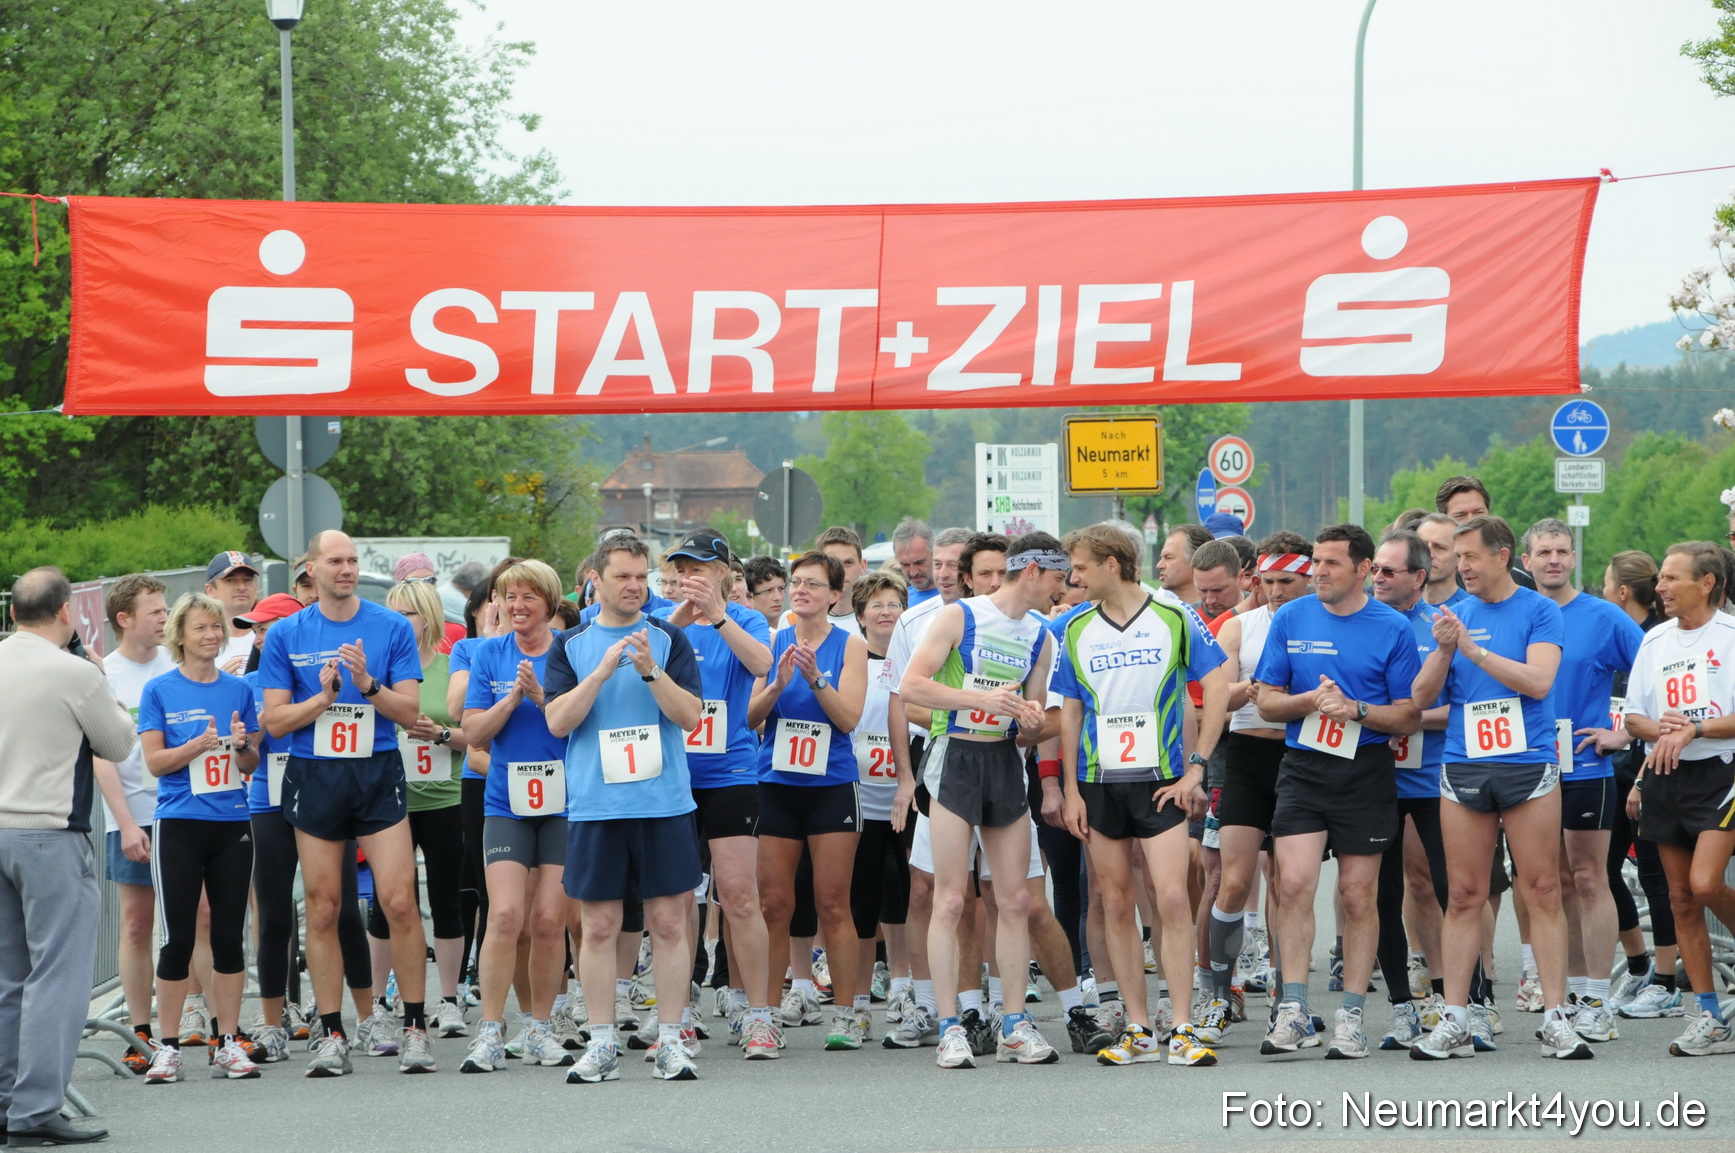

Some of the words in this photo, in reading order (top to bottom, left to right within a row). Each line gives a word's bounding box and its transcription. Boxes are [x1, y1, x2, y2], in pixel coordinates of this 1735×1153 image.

[1101, 431, 1126, 440] Nach
[1077, 445, 1150, 463] Neumarkt
[1220, 450, 1243, 471] 60
[1102, 469, 1108, 478] 5
[1115, 469, 1128, 478] km
[995, 496, 1011, 514] SHB
[978, 648, 1027, 668] BOCK
[1089, 648, 1162, 673] BOCK
[1662, 660, 1686, 672] MEYER
[973, 677, 1000, 687] MEYER
[1666, 673, 1697, 708] 86
[326, 705, 352, 713] MEYER
[1472, 702, 1498, 712] MEYER
[785, 721, 810, 730] MEYER
[1106, 716, 1134, 725] MEYER
[331, 721, 358, 753] 61
[609, 729, 637, 738] MEYER
[686, 716, 714, 746] 21
[785, 727, 810, 735] WERBUNG
[1316, 714, 1346, 748] 16
[1477, 716, 1512, 751] 66
[789, 736, 817, 767] 10
[1119, 731, 1136, 763] 2
[417, 745, 432, 775] 5
[517, 764, 543, 772] MEYER
[623, 743, 636, 774] 1
[868, 747, 897, 778] 25
[205, 753, 231, 787] 67
[527, 778, 544, 810] 9
[486, 846, 511, 855] ODLO
